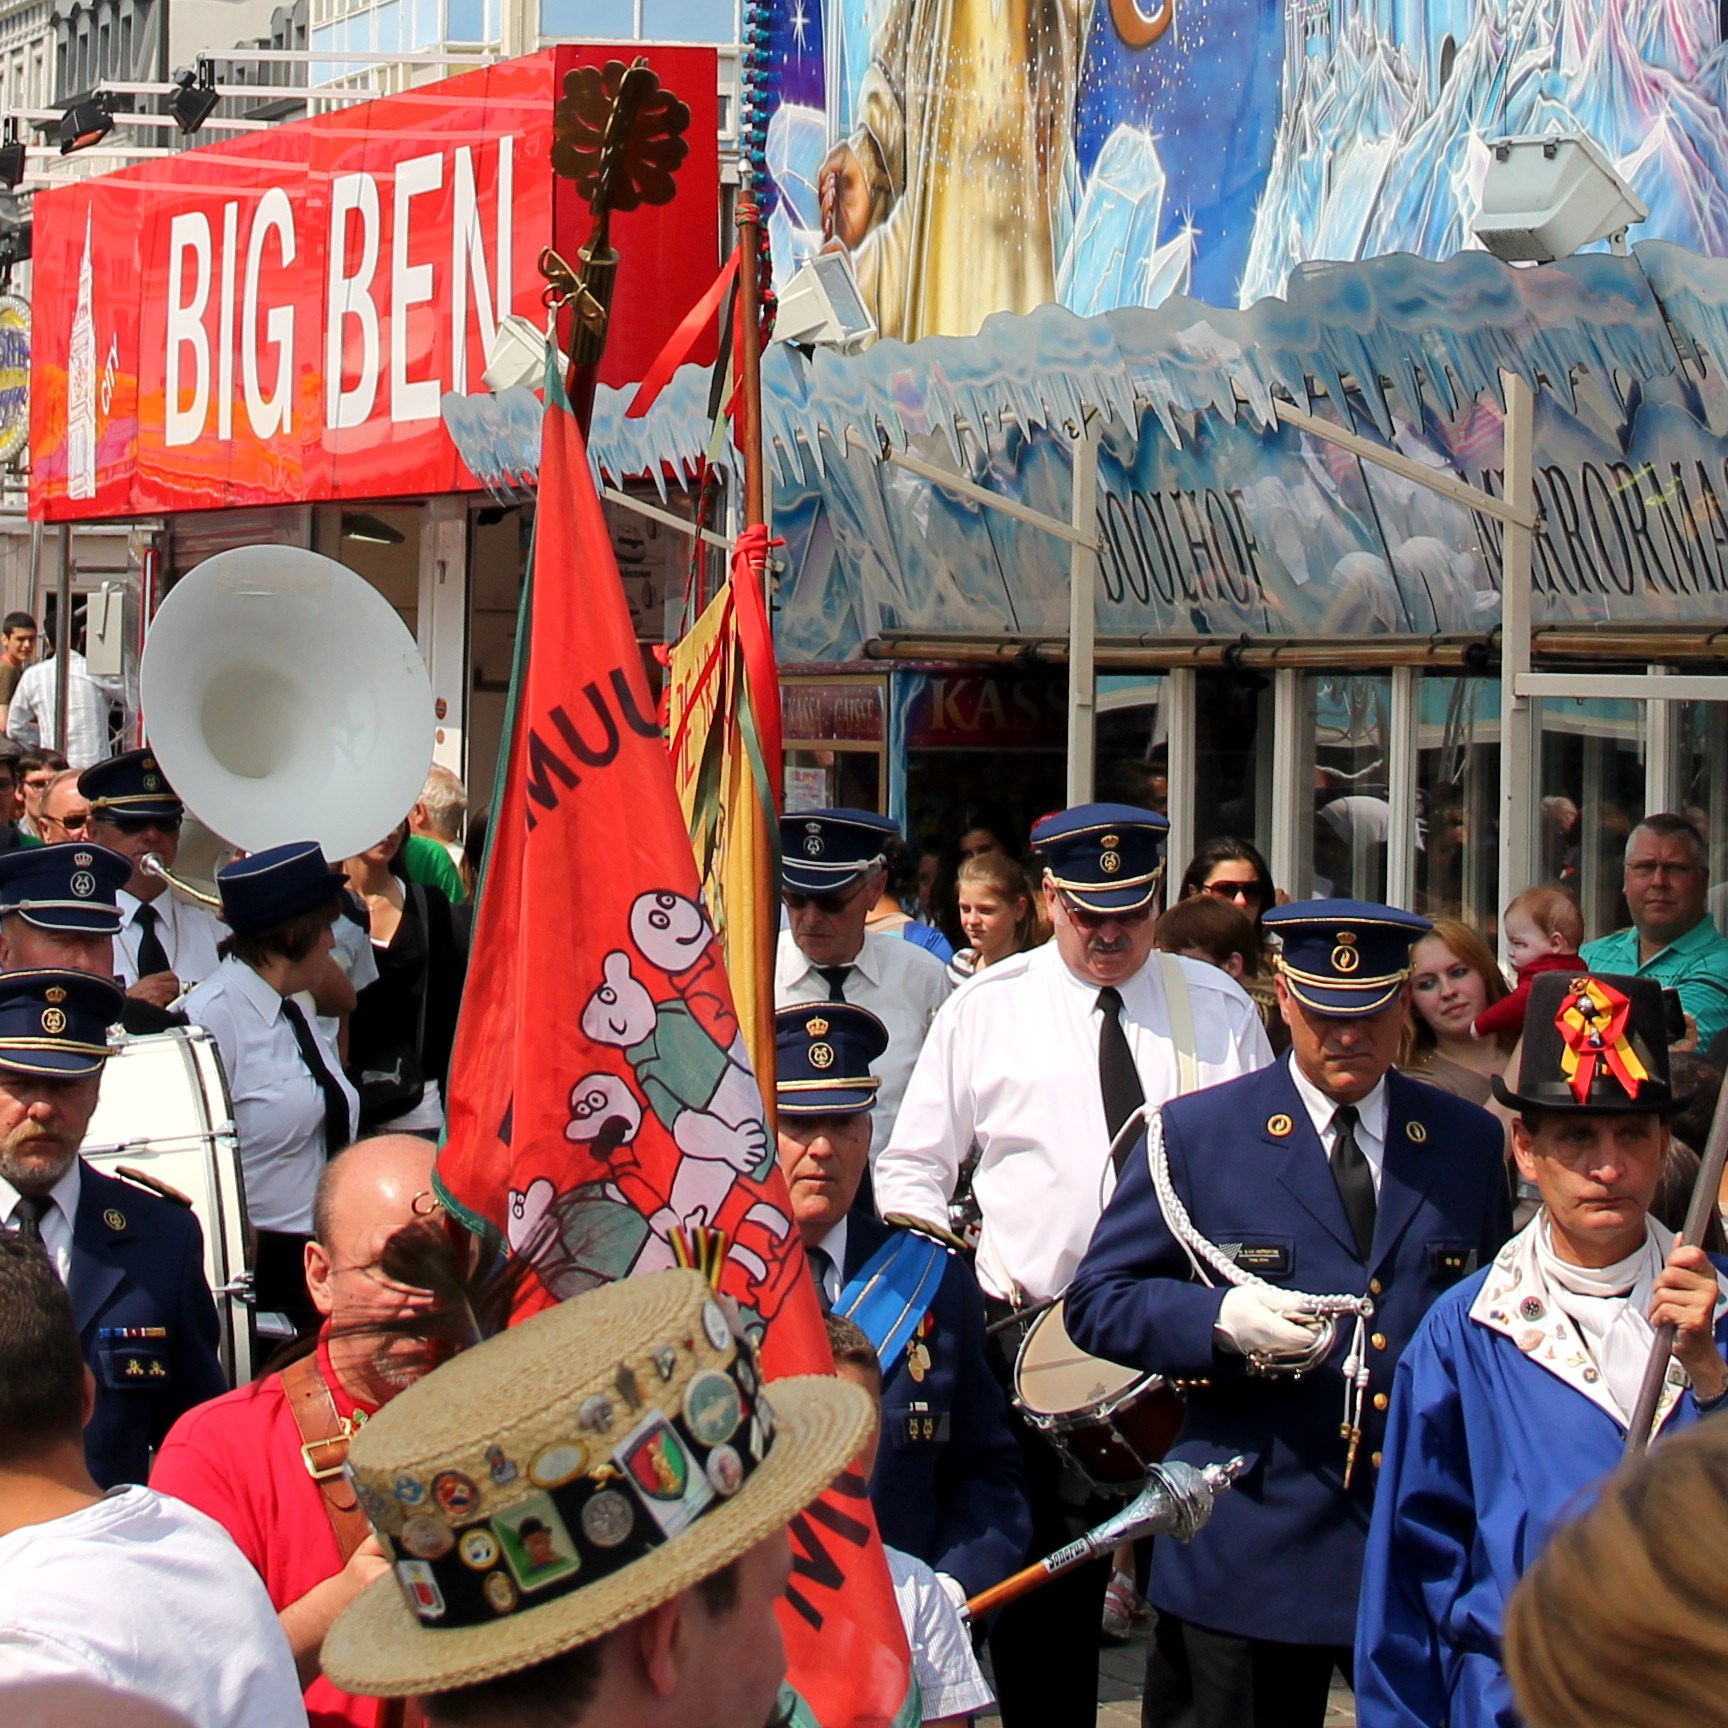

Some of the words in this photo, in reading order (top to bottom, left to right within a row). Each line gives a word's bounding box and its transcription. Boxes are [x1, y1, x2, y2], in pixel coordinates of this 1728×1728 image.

[101, 332, 119, 416] CITY
[165, 187, 297, 446] BIG
[326, 135, 514, 430] BEN
